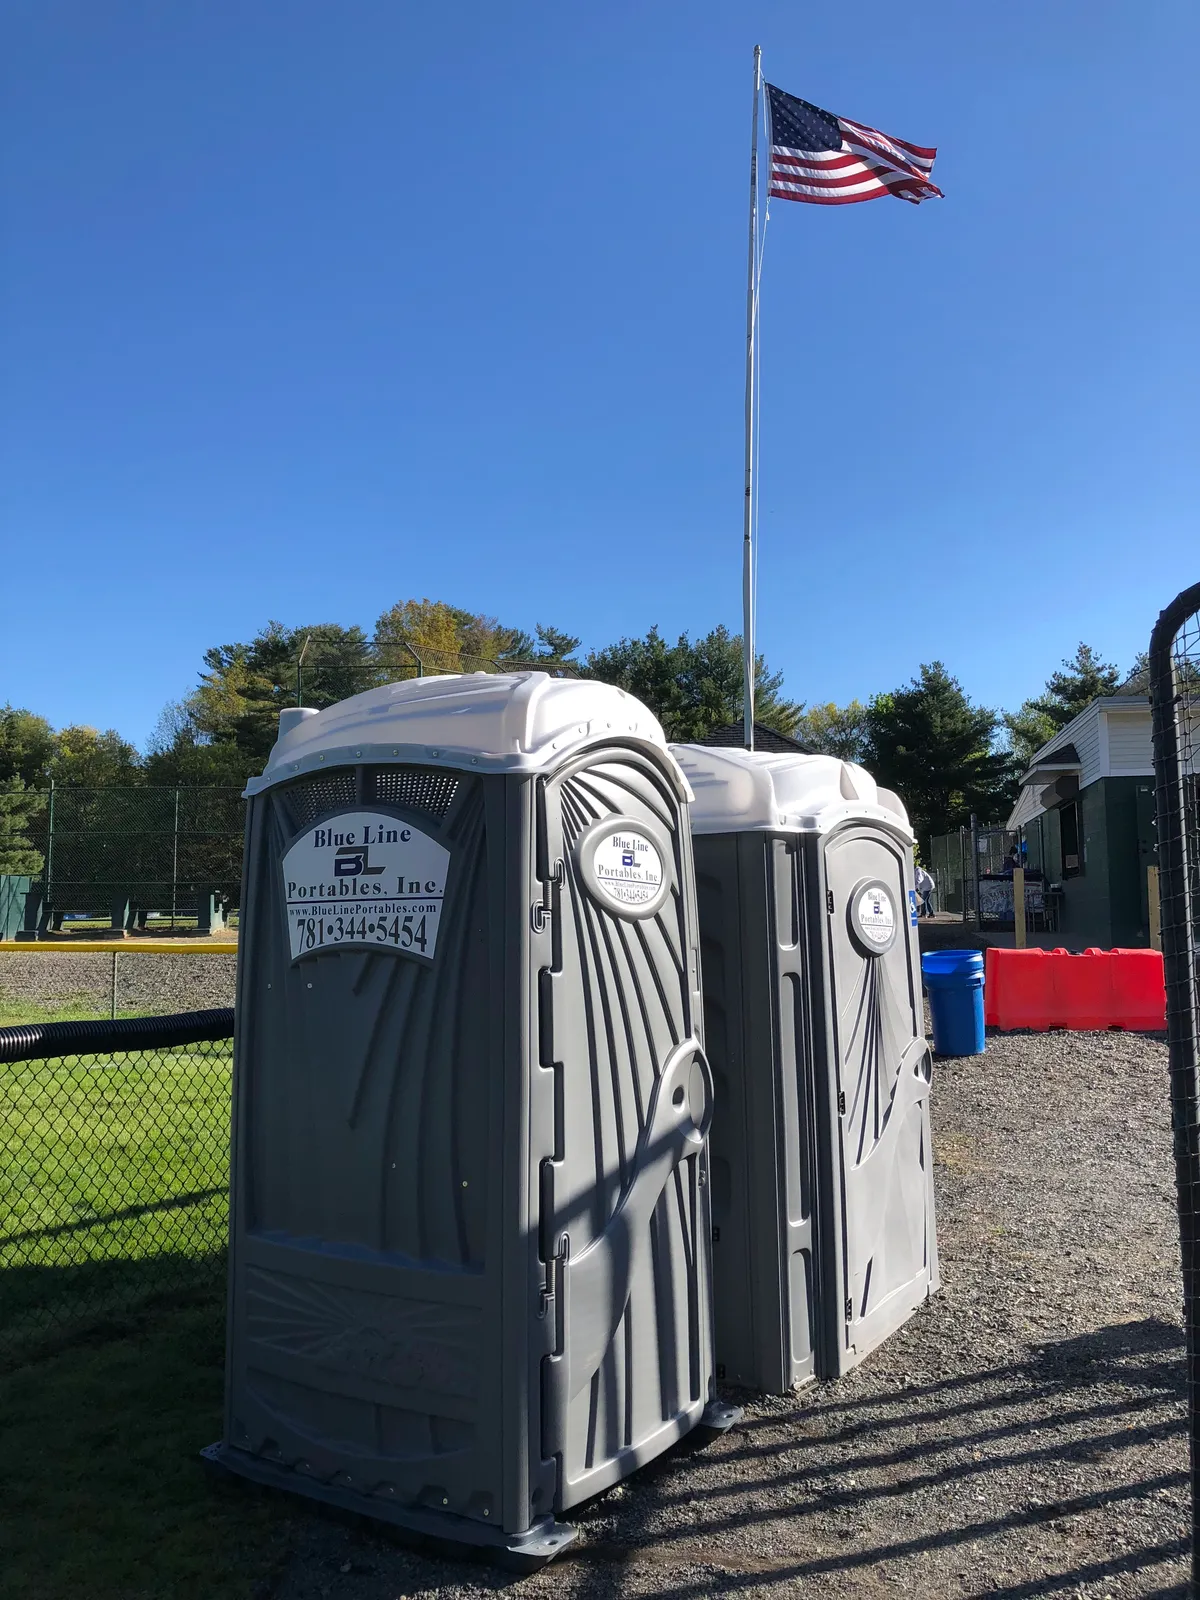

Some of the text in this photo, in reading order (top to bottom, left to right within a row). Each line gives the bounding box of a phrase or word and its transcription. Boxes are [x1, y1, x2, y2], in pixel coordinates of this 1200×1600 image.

[314, 825, 412, 848] Blue Line
[612, 836, 649, 852] Blue Line
[288, 876, 443, 898] Portables, Inc.
[290, 903, 437, 915] www.BlueLinePortables.com
